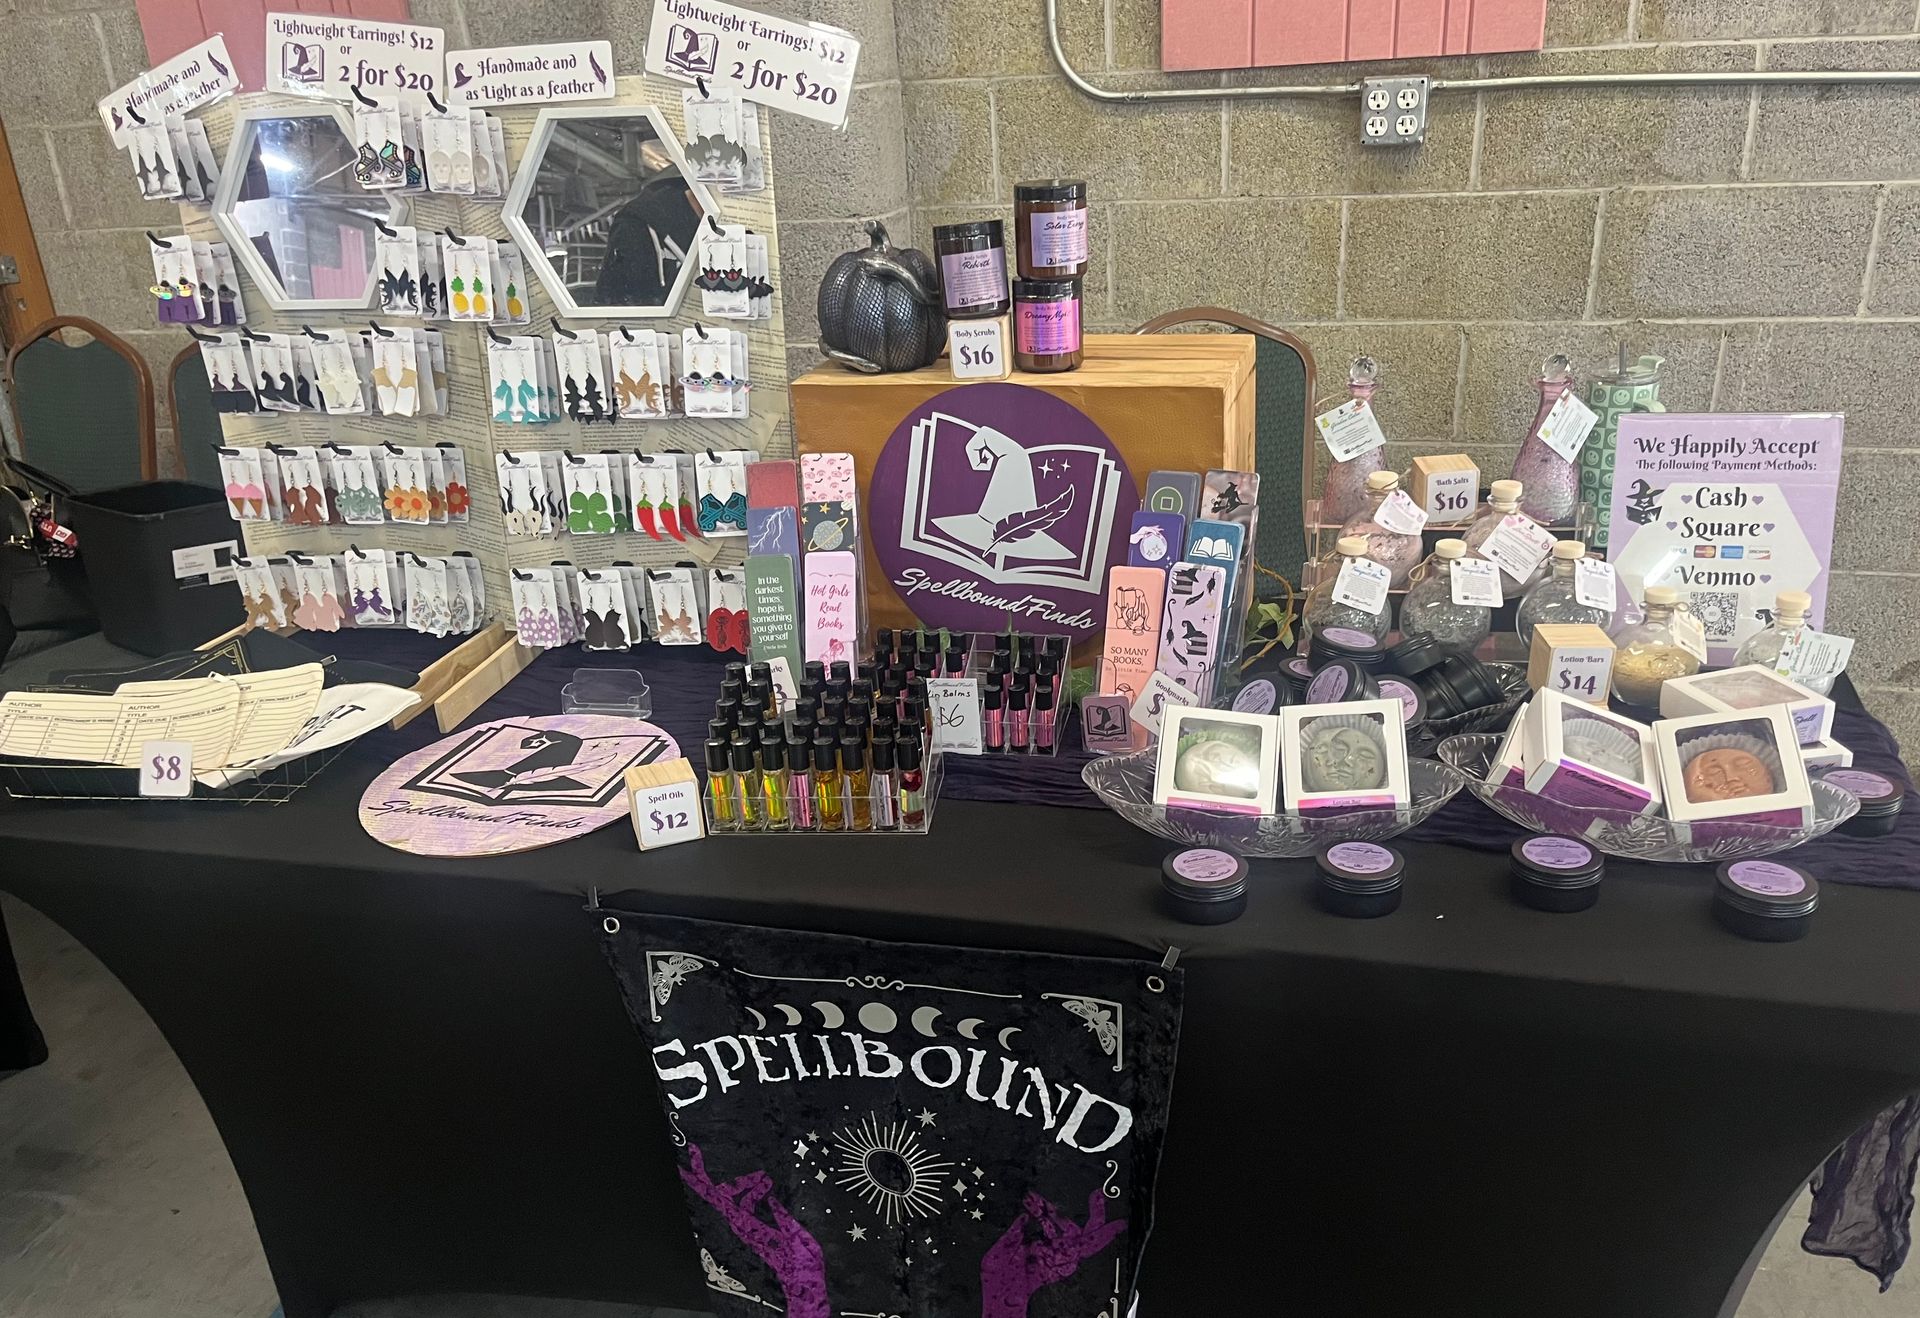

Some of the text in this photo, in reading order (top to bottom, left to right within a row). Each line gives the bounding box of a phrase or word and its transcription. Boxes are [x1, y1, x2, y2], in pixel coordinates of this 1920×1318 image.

[273, 18, 434, 51] Lightweight Earrings! $12
[665, 0, 846, 64] Lightweight Earrings! $12
[340, 45, 352, 55] or
[737, 40, 751, 51] or
[182, 60, 201, 80] and
[338, 59, 434, 92] 2 for $20
[477, 54, 577, 78] Handmade and
[466, 79, 595, 103] as Light as a feather
[731, 58, 837, 106] 2 for $20
[955, 328, 996, 339] Body Scrubs
[959, 343, 994, 369] $16
[1633, 434, 1820, 459] We Happily Accept
[1635, 459, 1818, 472] The following Payment Methods:
[1436, 477, 1469, 486] Bath Salts
[1433, 490, 1468, 514] $16
[1695, 486, 1748, 509] Cash
[1680, 516, 1762, 542] Square
[757, 576, 780, 585] In the
[1674, 565, 1756, 588] Venmo
[754, 585, 784, 595] darkest
[810, 584, 851, 599] Hot Girls
[893, 566, 1097, 630] Spellbound Finds
[757, 604, 785, 615] hope is
[819, 601, 842, 614] Read
[752, 613, 792, 623] something
[817, 617, 844, 630] Books
[752, 623, 793, 635] you give to
[758, 633, 789, 643] yourself
[1110, 646, 1149, 656] SO MANY
[1559, 655, 1604, 663] Lotion Bars
[1557, 667, 1597, 695] $14
[942, 688, 971, 698] Balms
[1155, 679, 1190, 706] Bookmarks
[937, 703, 965, 728] $6
[151, 753, 182, 785] $8
[648, 790, 684, 804] Spell Oils
[507, 812, 587, 829] Finds
[650, 808, 689, 835] $12
[652, 1031, 1133, 1153] SPELLBOUND
